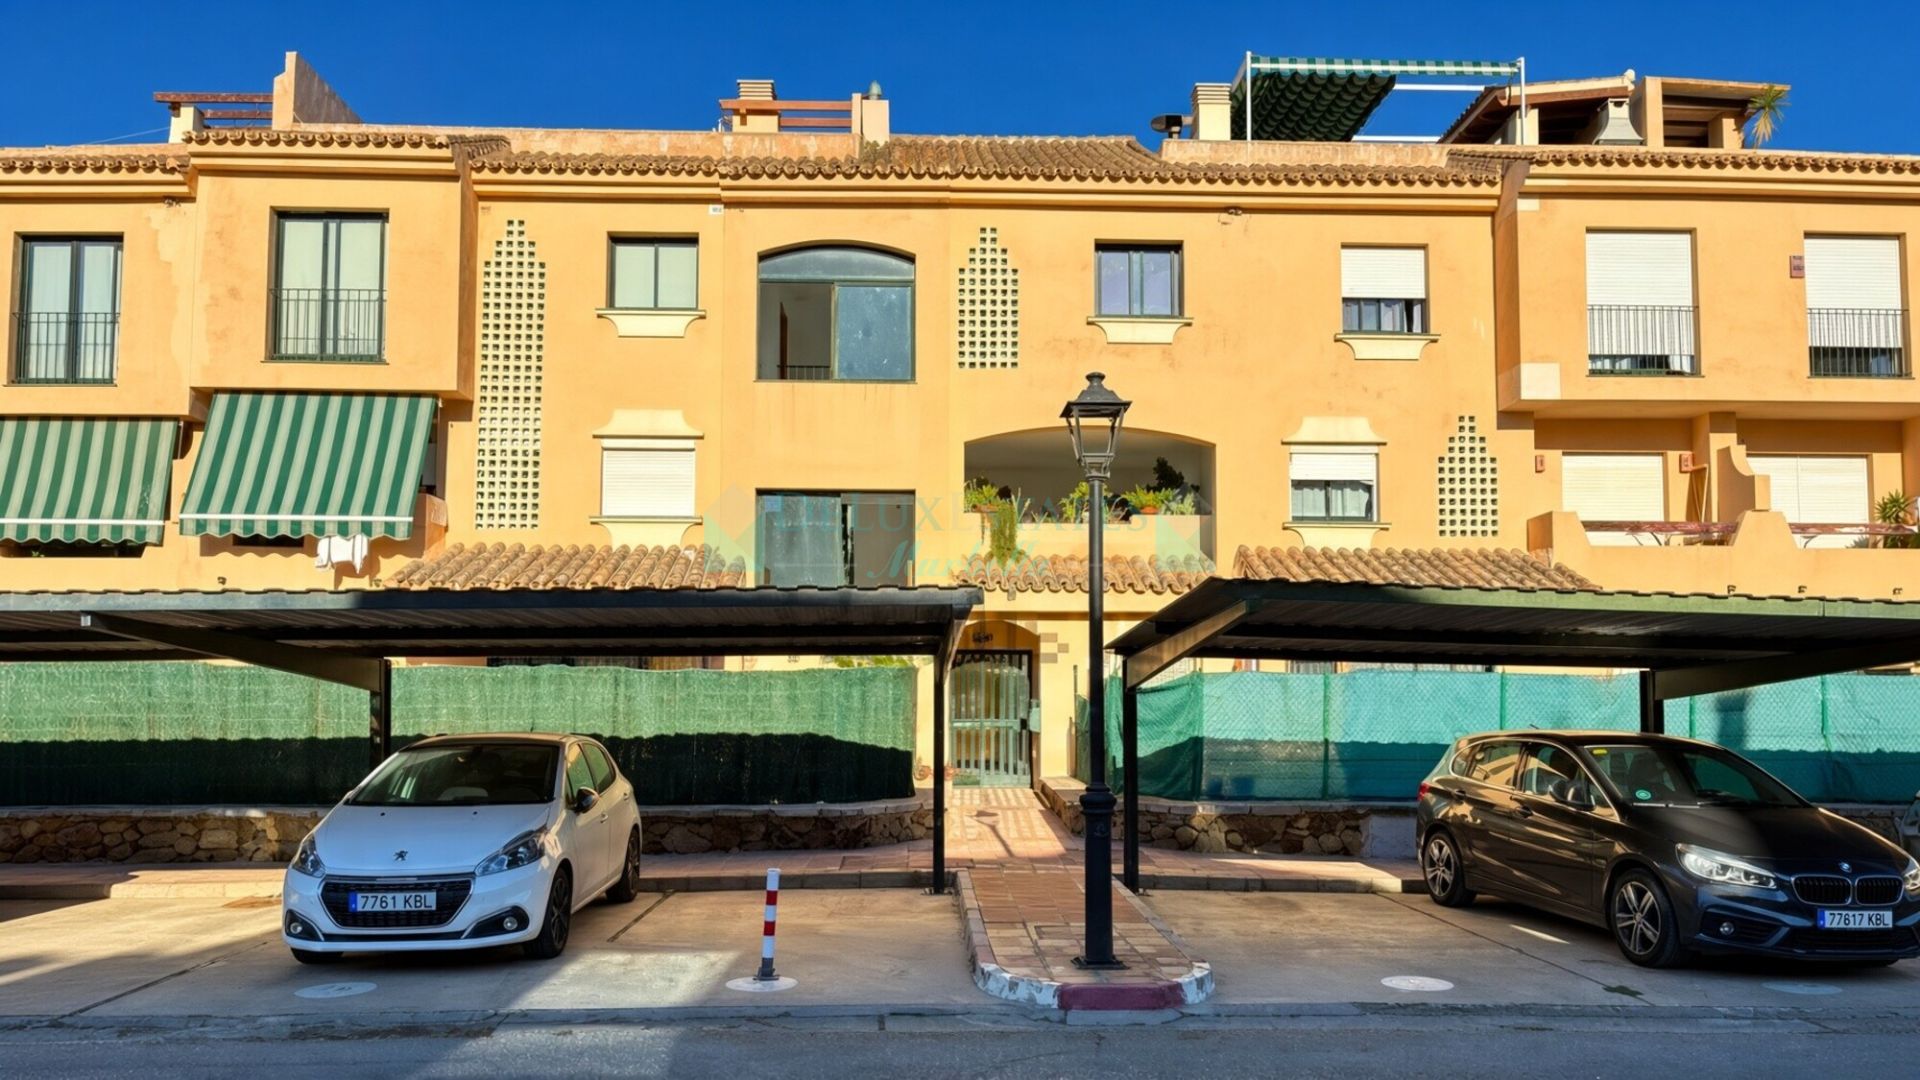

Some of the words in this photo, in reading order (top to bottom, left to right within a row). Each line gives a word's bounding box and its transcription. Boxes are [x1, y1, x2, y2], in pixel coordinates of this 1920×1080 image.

[360, 895, 396, 910] 7761
[404, 894, 433, 909] KBL
[1868, 913, 1890, 926] KBL
